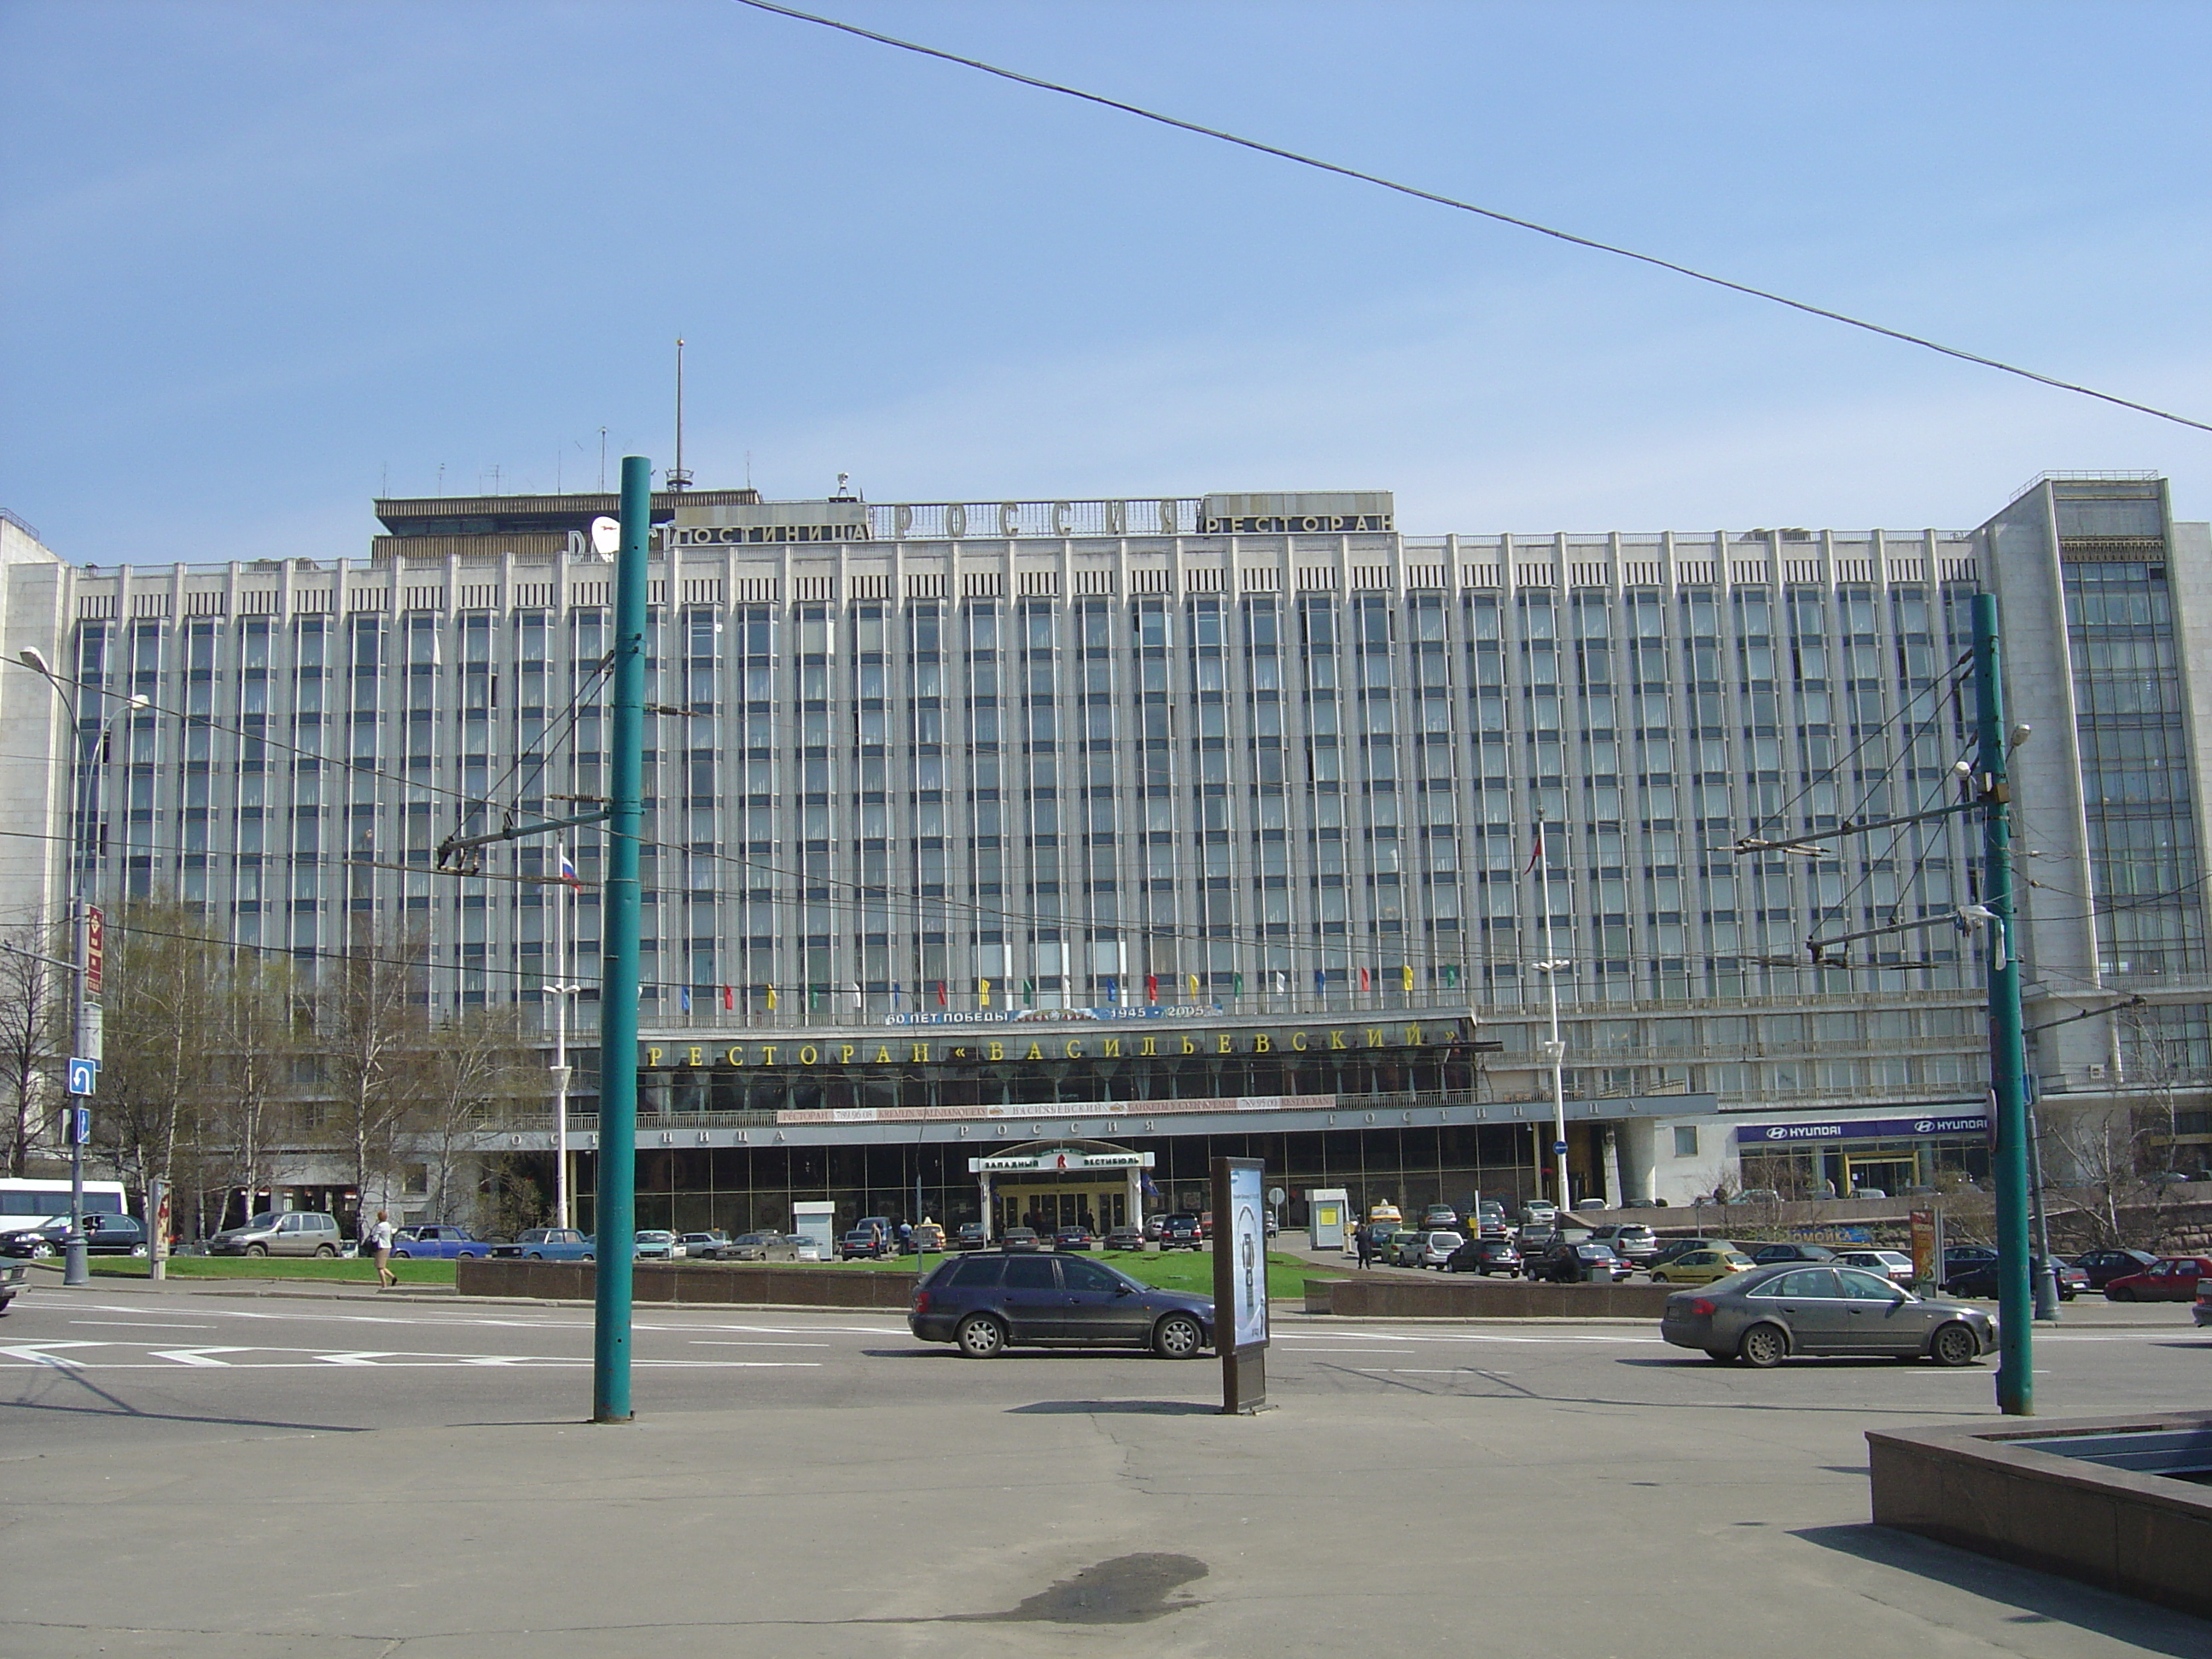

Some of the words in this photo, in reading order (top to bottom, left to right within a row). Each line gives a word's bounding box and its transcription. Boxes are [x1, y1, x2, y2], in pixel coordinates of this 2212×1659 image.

[894, 500, 1177, 539] РОССИЯ
[1206, 515, 1394, 533] РЕСТОРАН
[678, 525, 867, 544] ГОСТИНИЦА
[888, 1014, 905, 1023] 60
[944, 1012, 1008, 1022] ПОБЕДЫ
[1111, 1007, 1146, 1018] 1945
[1167, 1005, 1204, 1016] 2005
[650, 1043, 930, 1067] РЕСТОРАН
[783, 1111, 828, 1121] РЕСТОРАН
[961, 1120, 1155, 1137] РОССИЯ
[1790, 1126, 1841, 1138] HYUNDAI
[1938, 1119, 1988, 1131] HYUNDAI
[473, 1130, 785, 1145] ГОСТНИЦА
[985, 1161, 1039, 1169] ЗАПАДНЫЙ
[1084, 1157, 1139, 1166] ВЕСТИБЮЛЬ
